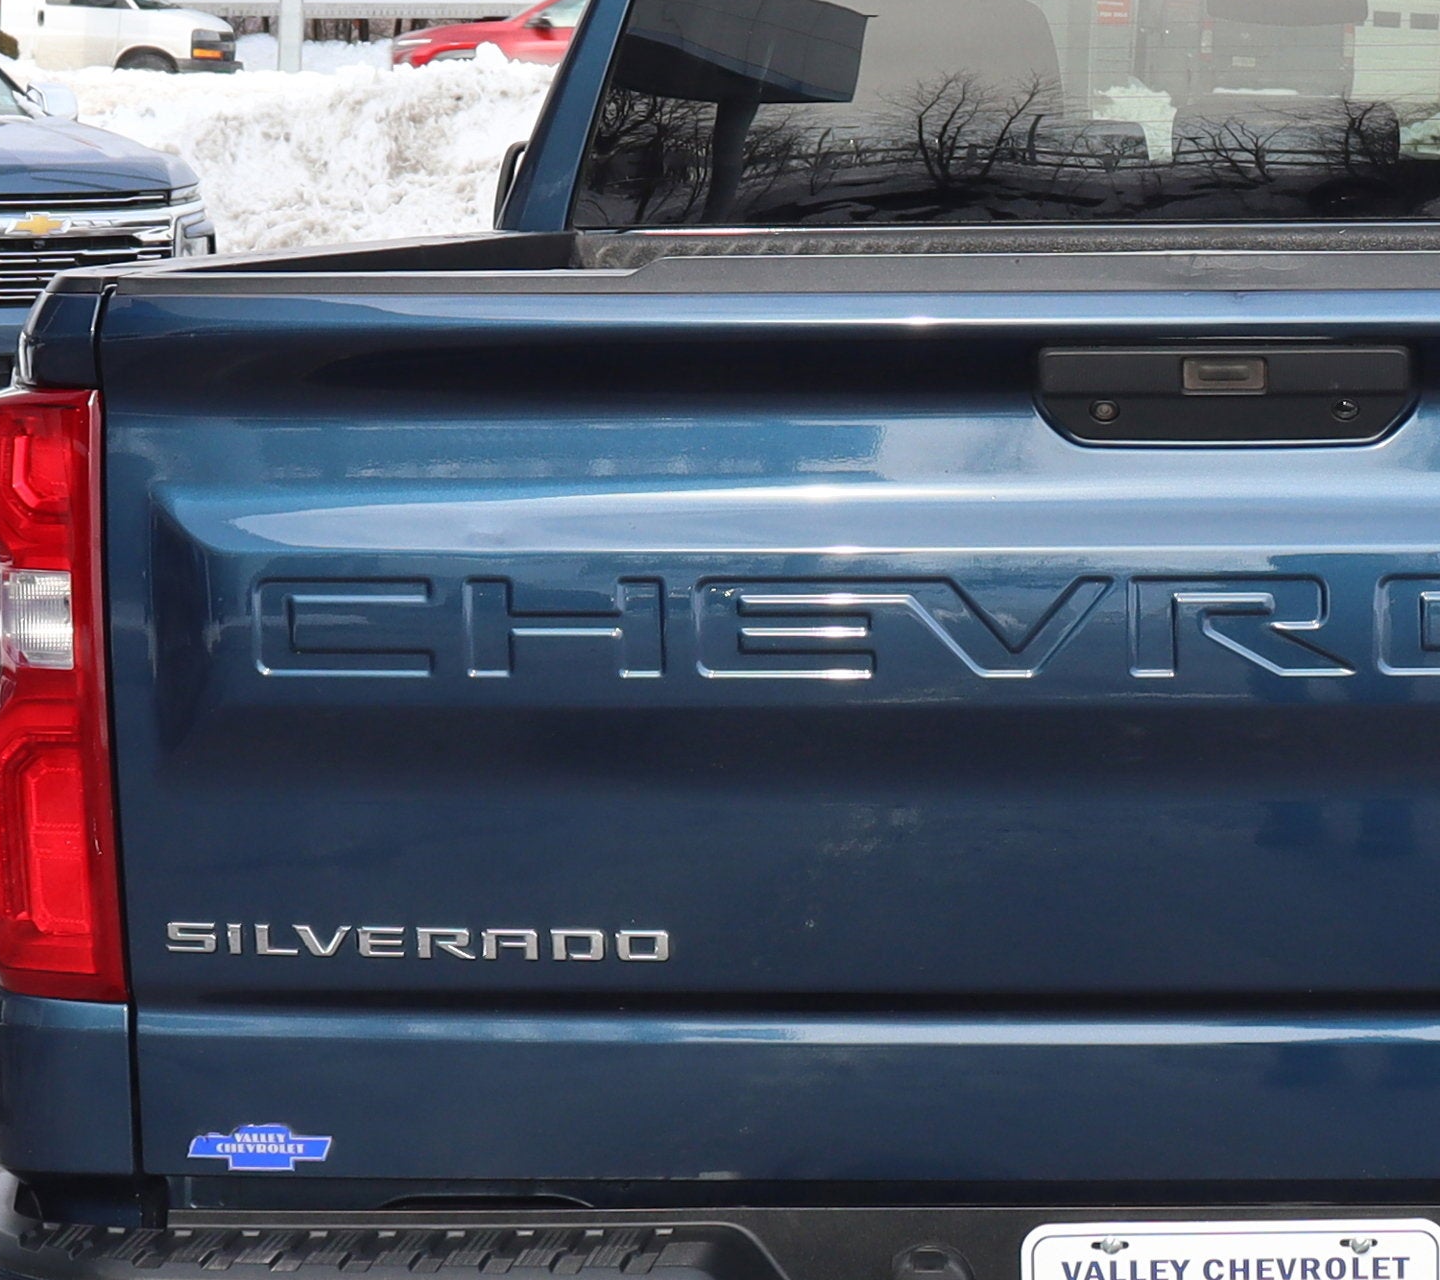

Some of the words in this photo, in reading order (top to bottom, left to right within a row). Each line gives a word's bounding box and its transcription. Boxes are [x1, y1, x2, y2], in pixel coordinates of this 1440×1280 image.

[165, 921, 671, 962] SILVERADO
[234, 1133, 286, 1143] VALLEY
[216, 1143, 305, 1154] CHEVROLET
